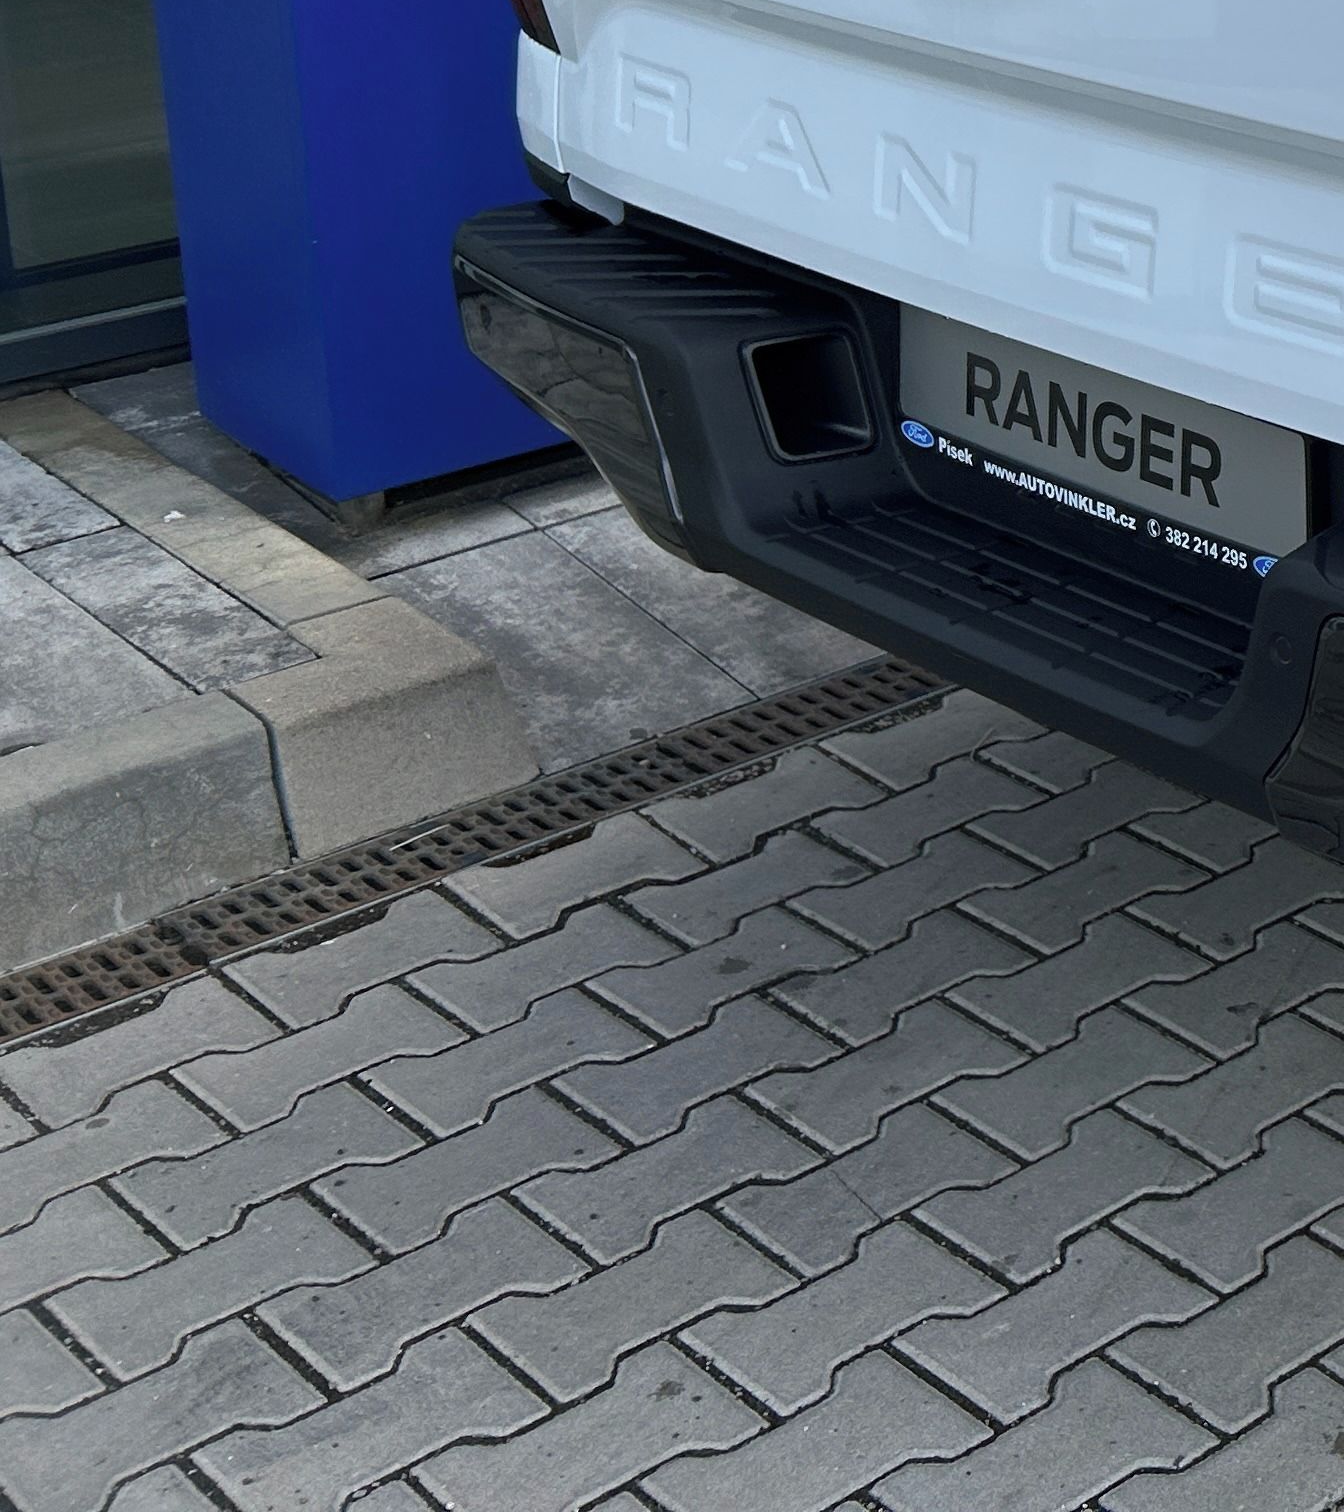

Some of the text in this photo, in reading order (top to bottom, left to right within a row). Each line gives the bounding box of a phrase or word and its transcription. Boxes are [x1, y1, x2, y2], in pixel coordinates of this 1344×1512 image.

[966, 351, 1222, 508] RANGER
[983, 459, 1137, 531] www.AUTOVINKLER.cz
[1165, 526, 1190, 550] 382
[1193, 536, 1219, 560] 214
[1221, 546, 1248, 570] 295
